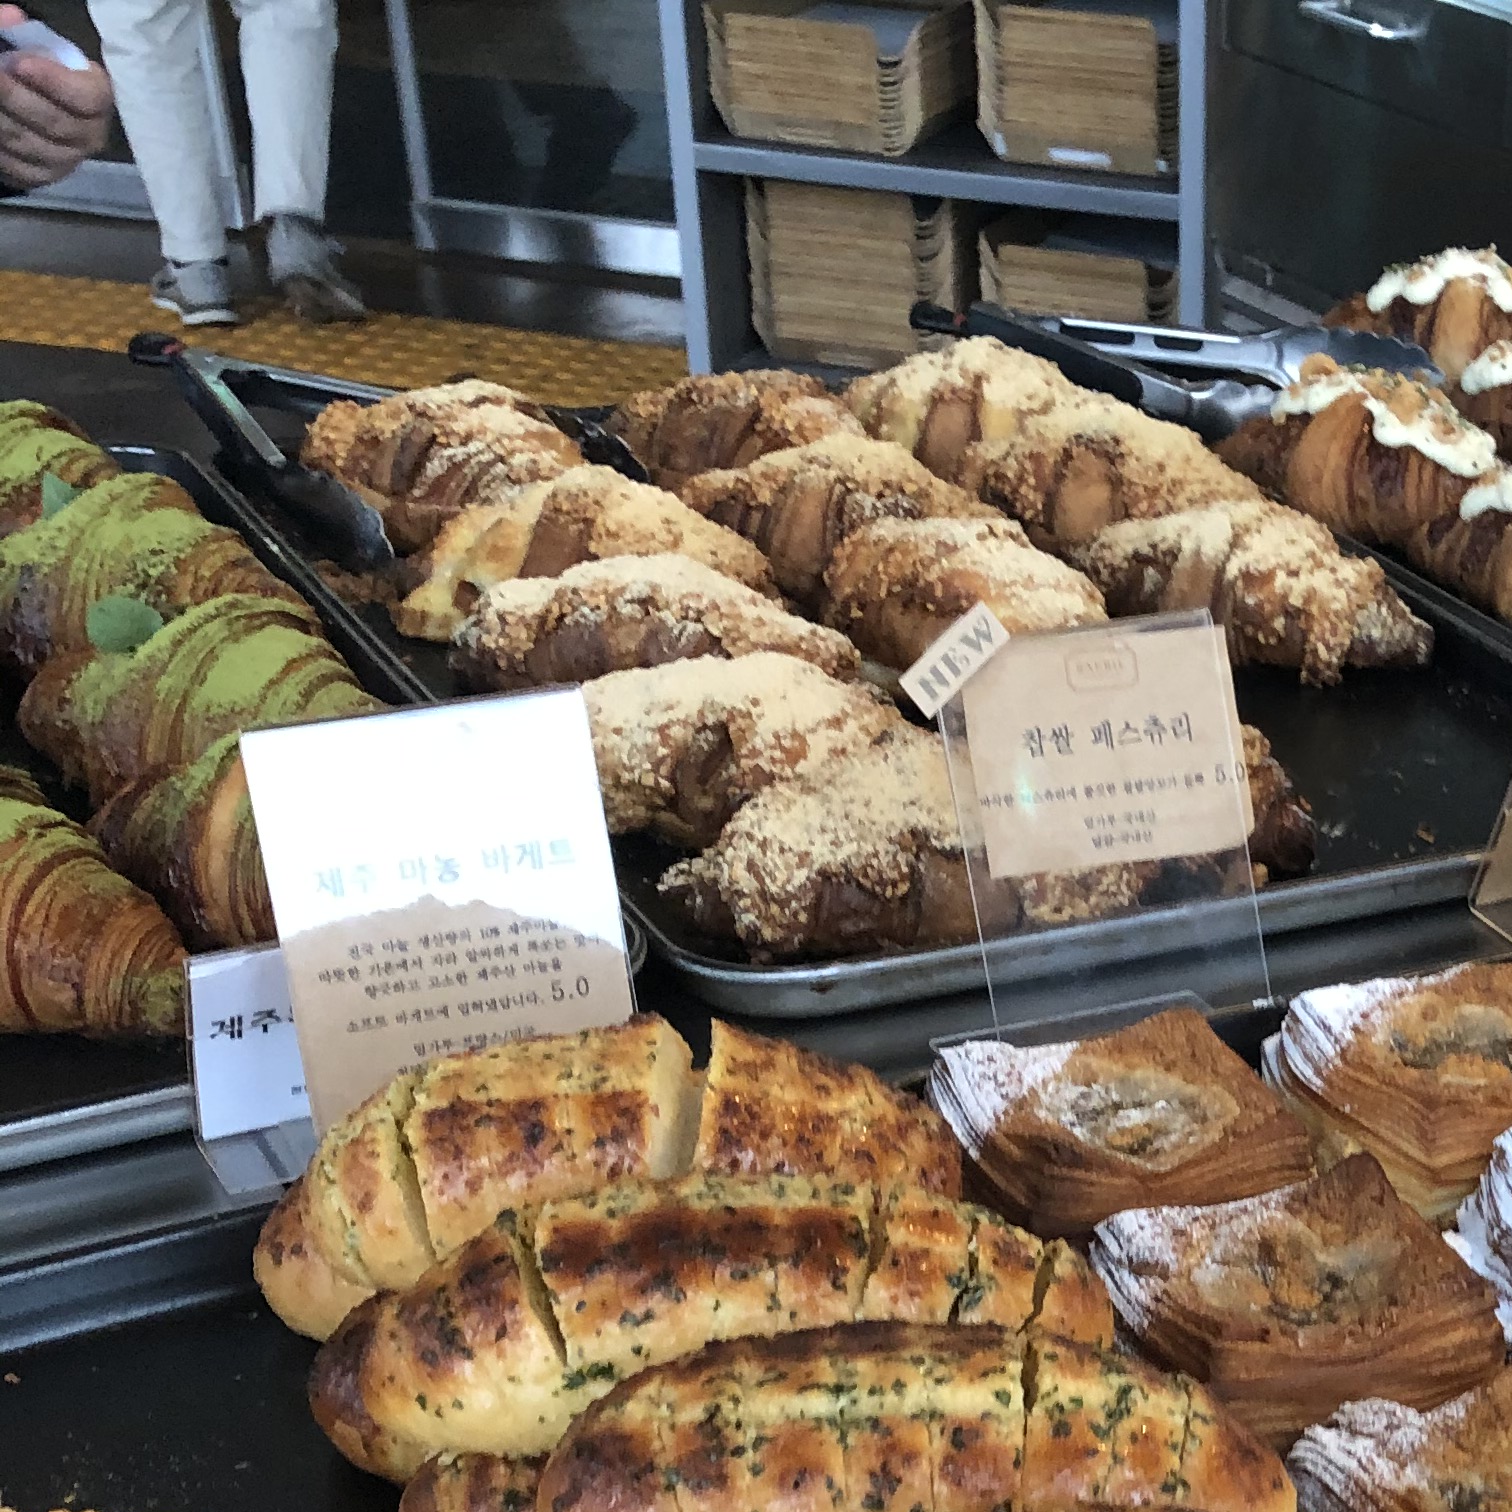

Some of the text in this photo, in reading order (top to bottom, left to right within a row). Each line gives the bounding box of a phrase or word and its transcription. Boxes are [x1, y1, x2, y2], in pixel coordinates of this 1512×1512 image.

[918, 614, 994, 702] NEW
[1022, 711, 1193, 758] 찹쌀 페스츄리
[315, 865, 375, 898] 제주
[481, 839, 575, 873] 바게트
[551, 975, 589, 1001] 5.0
[210, 1006, 294, 1040] 제주
